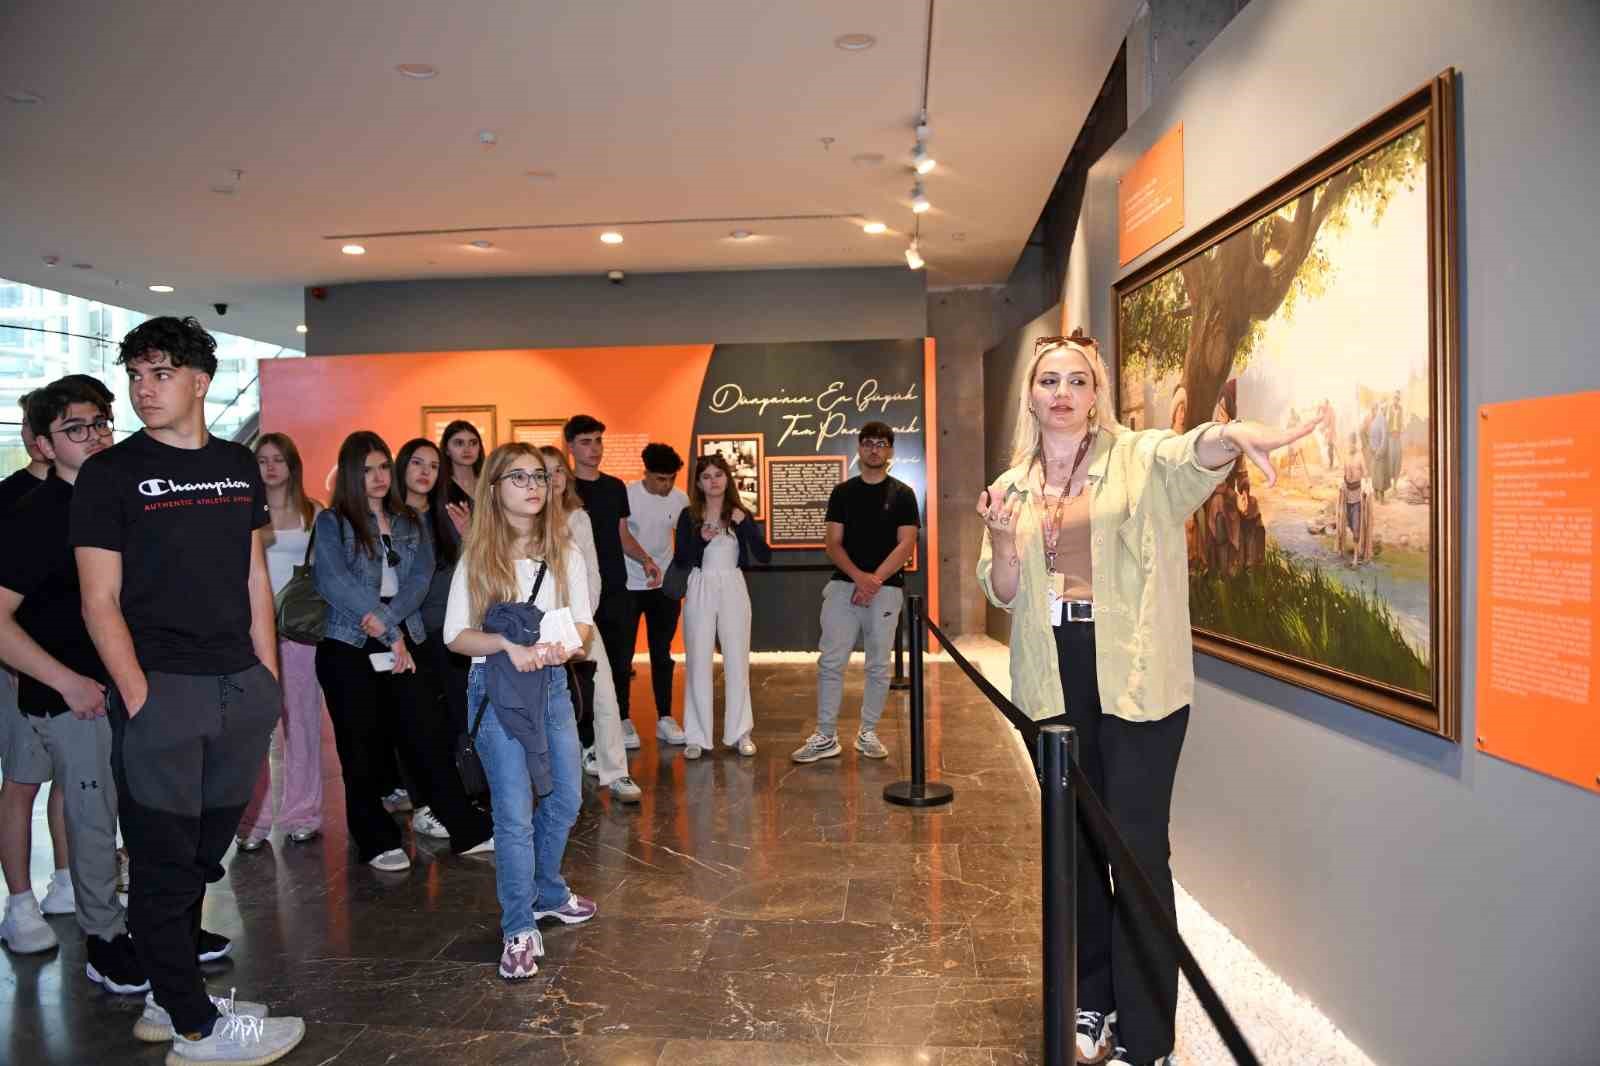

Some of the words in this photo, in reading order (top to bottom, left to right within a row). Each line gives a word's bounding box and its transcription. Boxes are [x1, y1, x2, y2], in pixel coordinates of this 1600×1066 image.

[817, 381, 852, 411] En
[777, 414, 817, 448] Tam
[138, 477, 250, 496] Champion
